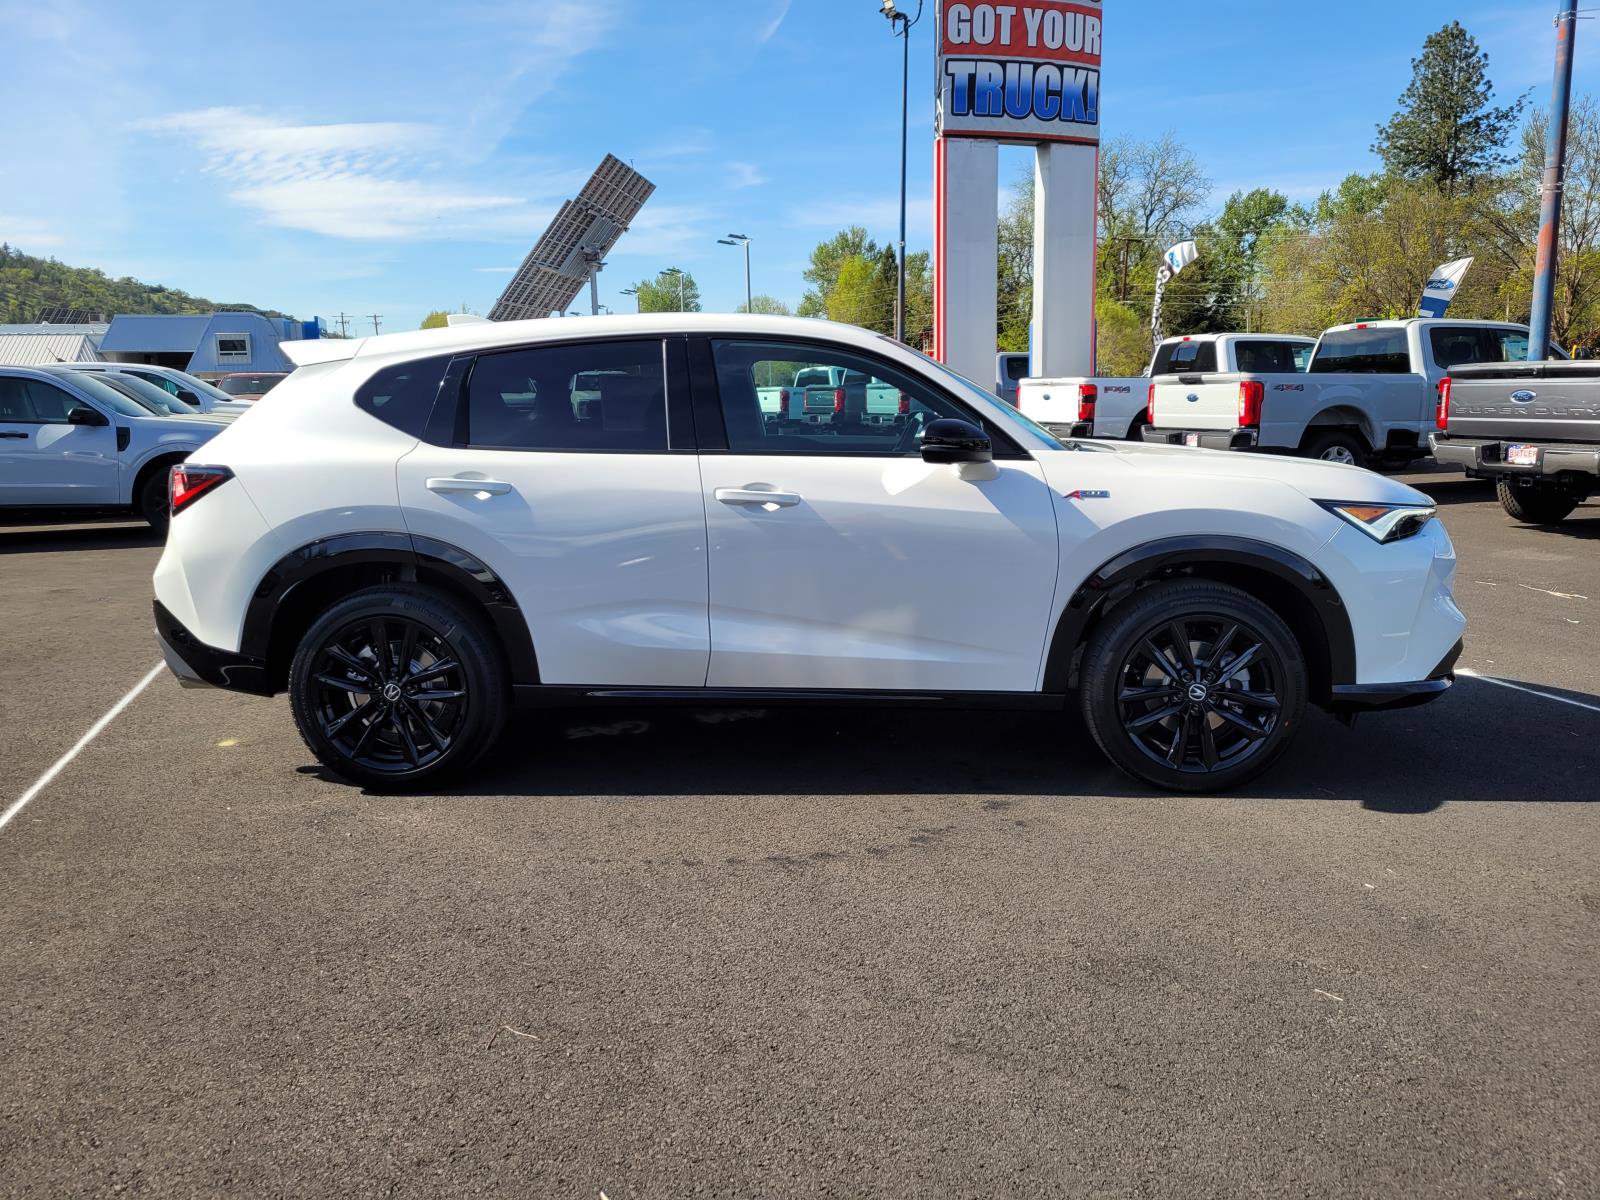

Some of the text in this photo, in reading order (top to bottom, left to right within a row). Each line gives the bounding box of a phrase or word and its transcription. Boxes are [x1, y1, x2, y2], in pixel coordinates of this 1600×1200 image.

[947, 4, 1100, 55] GOT YOUR
[945, 58, 1099, 125] TRUCK!
[1455, 407, 1600, 416] SUPER DUTY
